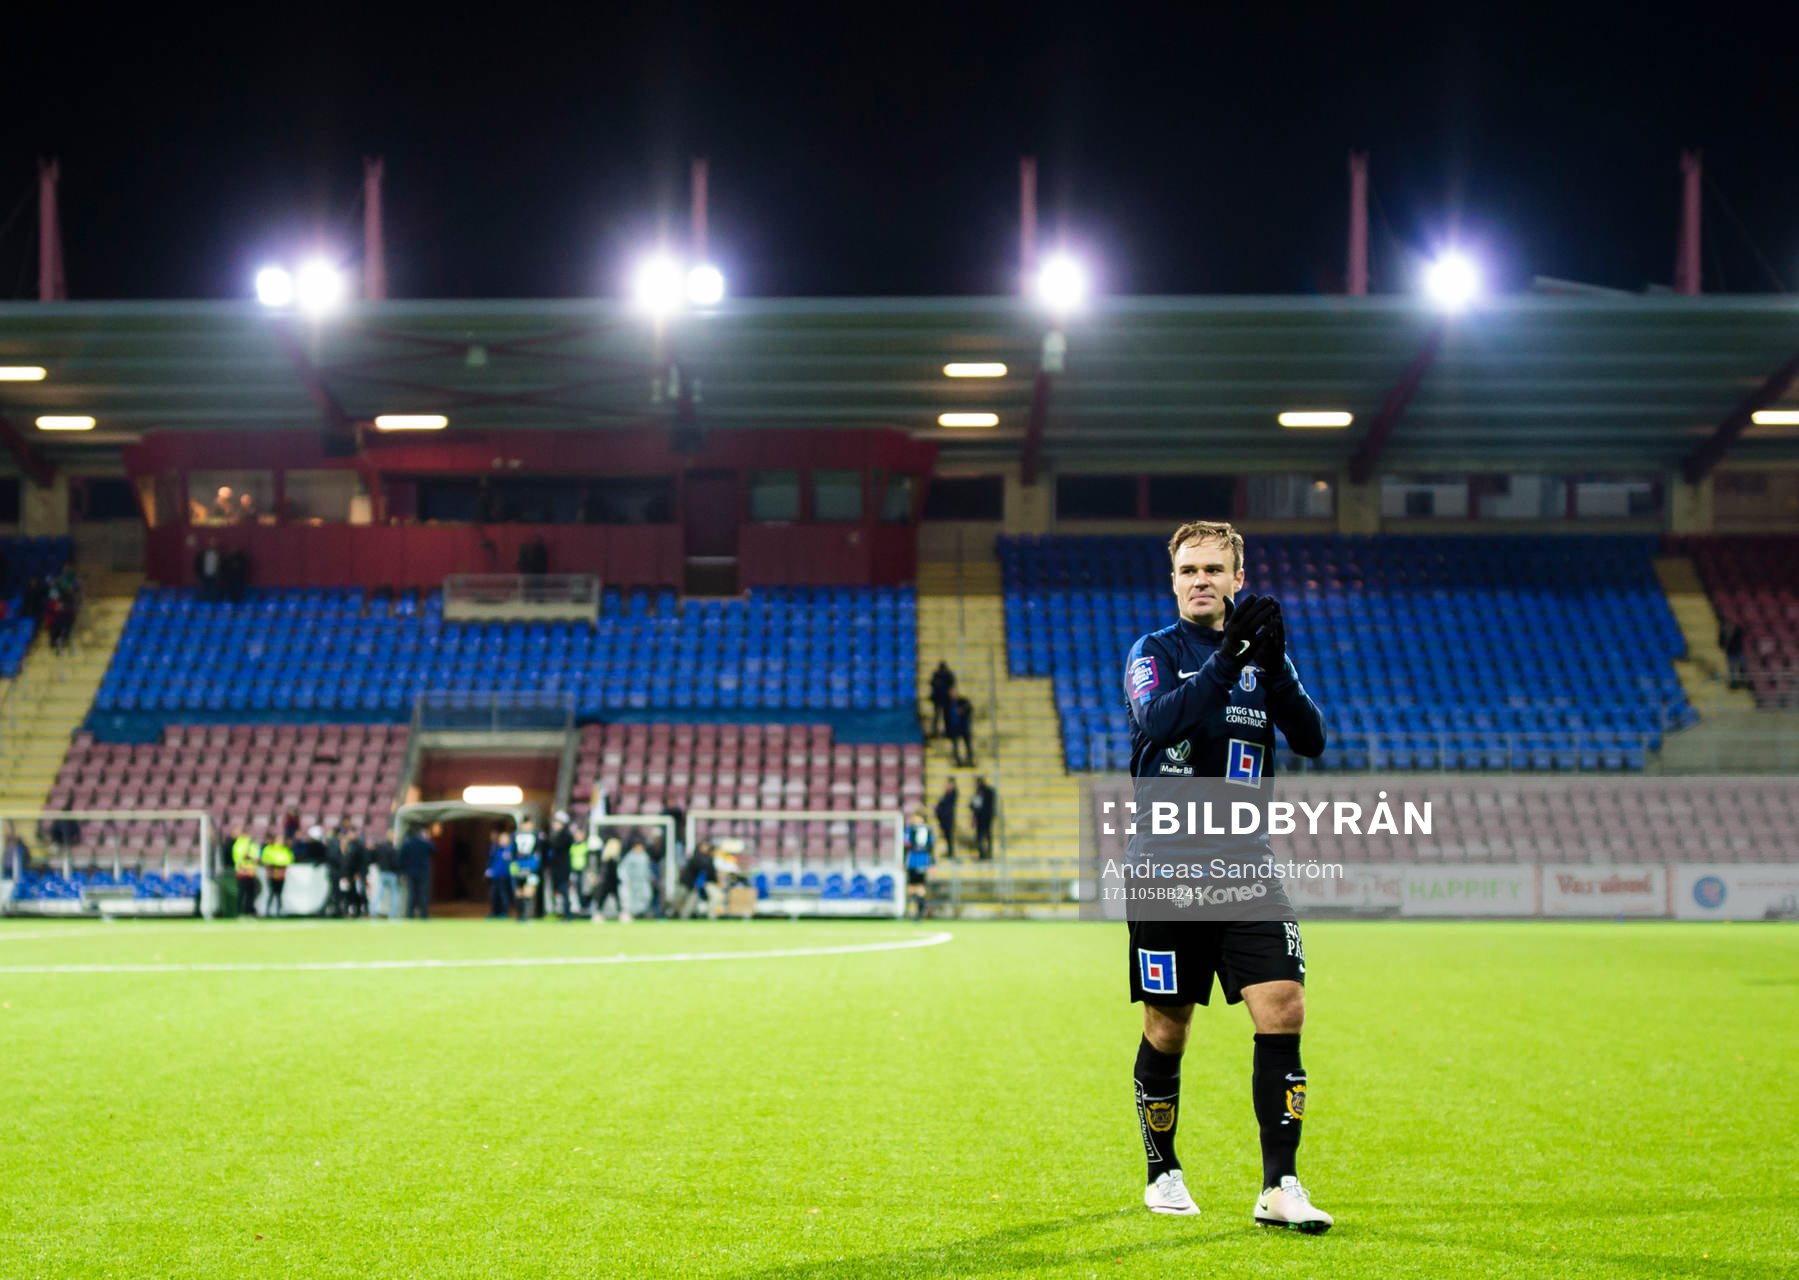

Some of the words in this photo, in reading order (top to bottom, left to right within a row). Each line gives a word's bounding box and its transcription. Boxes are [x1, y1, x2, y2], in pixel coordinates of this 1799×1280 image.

[1226, 706, 1247, 716] BYGG
[1226, 714, 1267, 729] CONSTRUCT
[1408, 879, 1521, 899] HAPPIFY
